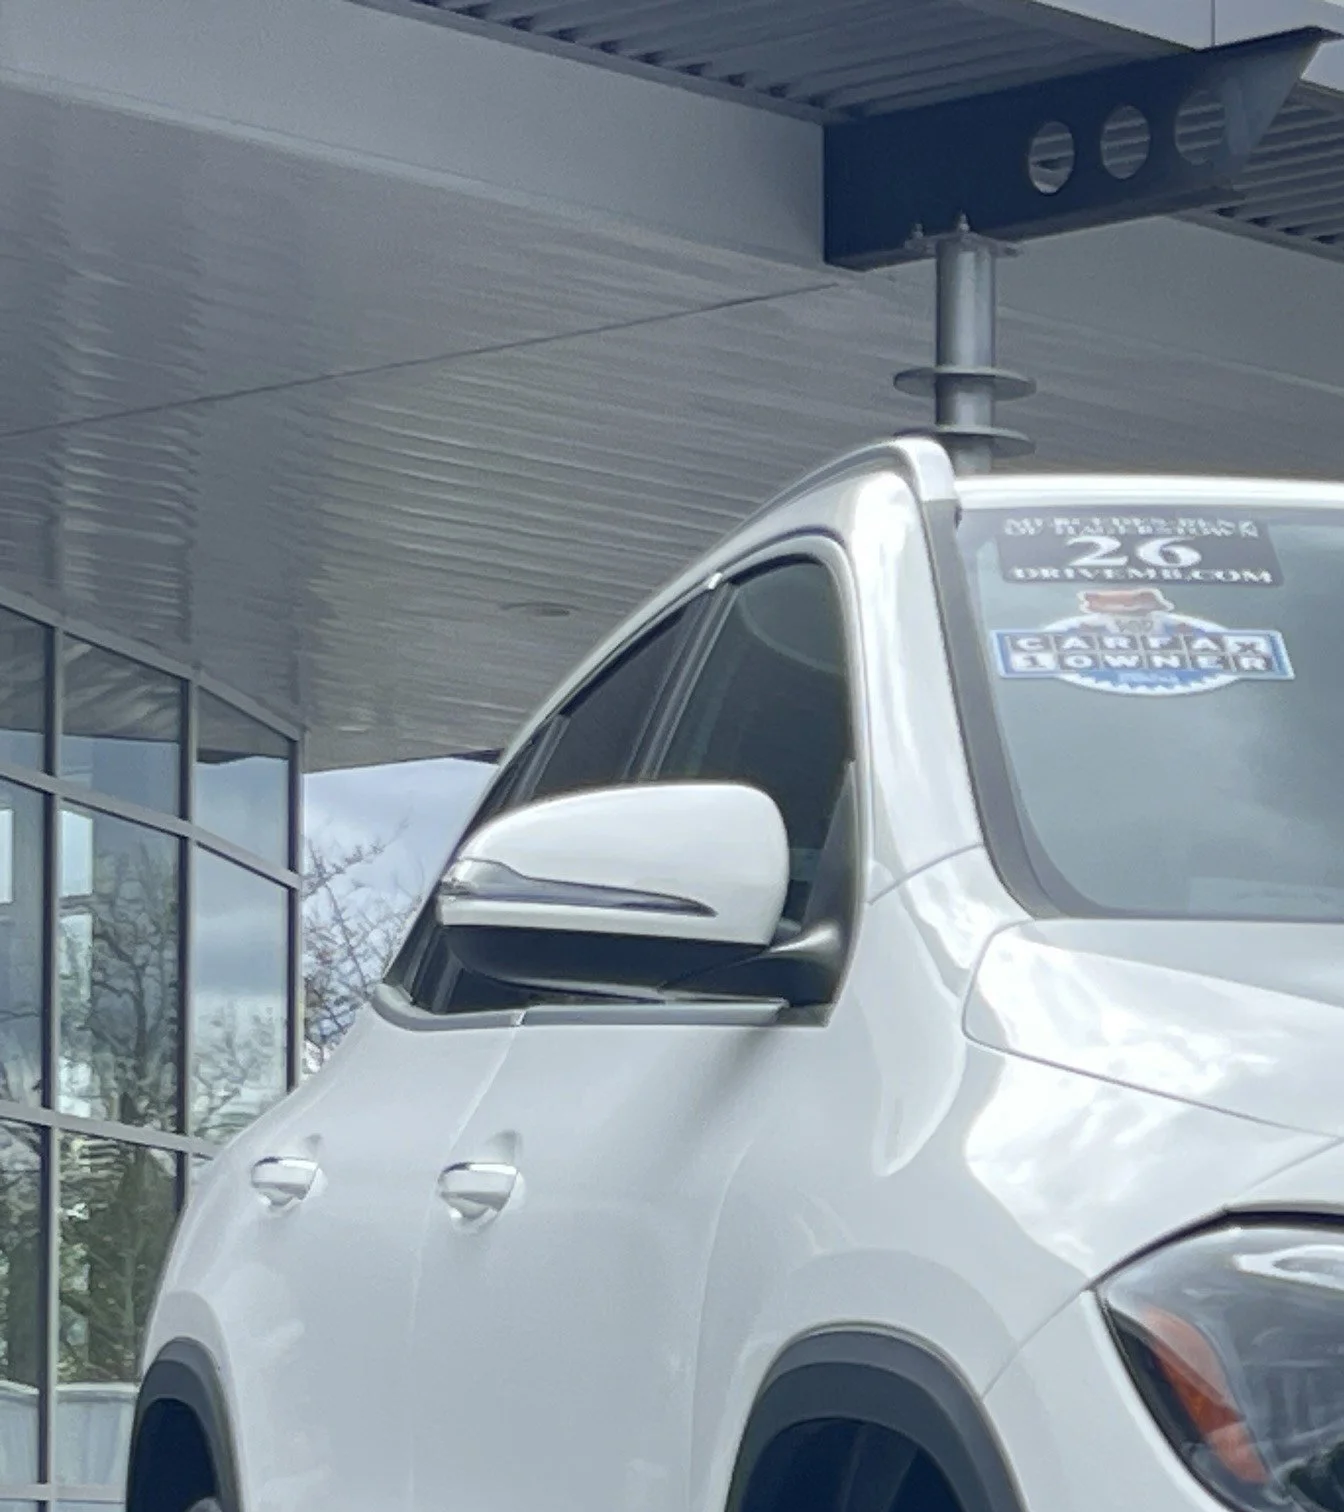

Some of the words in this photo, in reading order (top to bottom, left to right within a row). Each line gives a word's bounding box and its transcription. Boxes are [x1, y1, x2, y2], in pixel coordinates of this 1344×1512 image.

[1065, 536, 1203, 568] 26
[1015, 633, 1268, 654] CARFAX
[1069, 654, 1270, 671] OWNER
